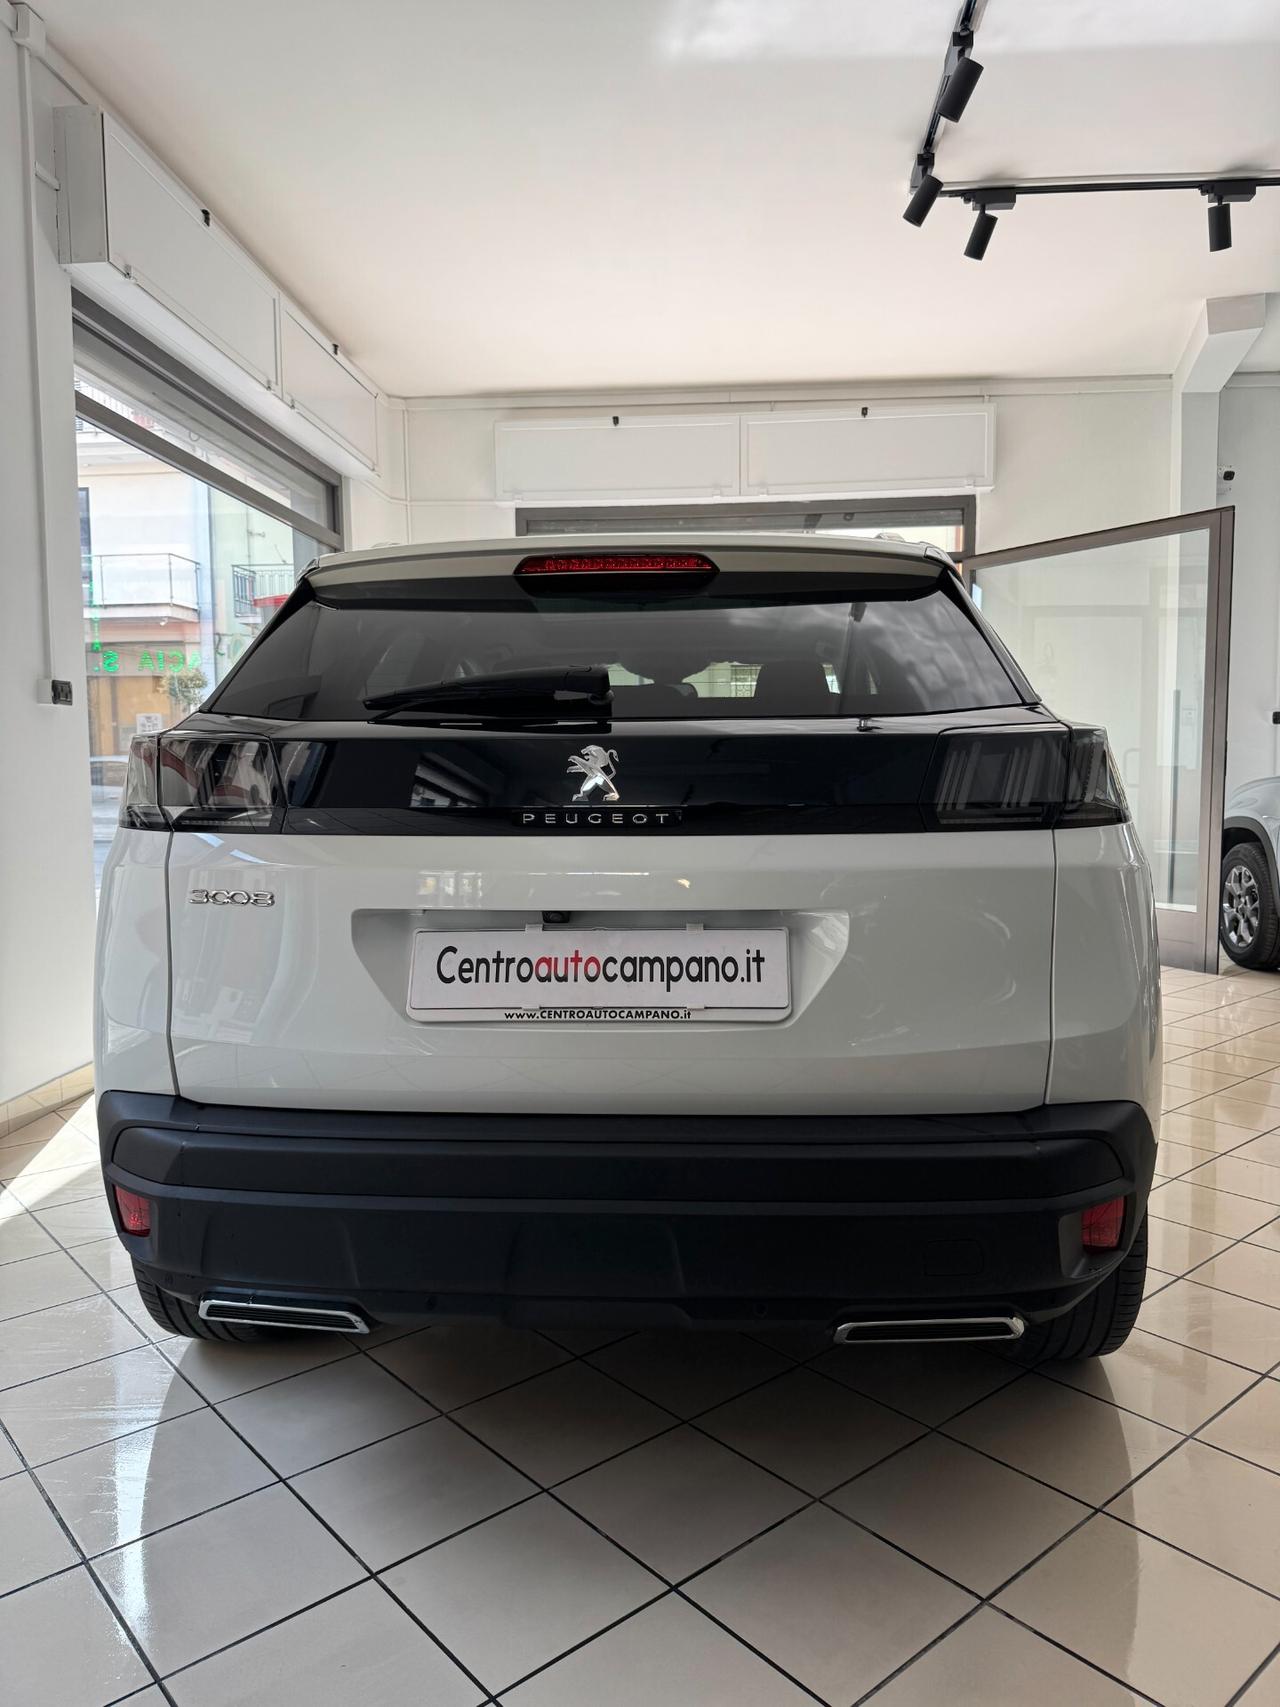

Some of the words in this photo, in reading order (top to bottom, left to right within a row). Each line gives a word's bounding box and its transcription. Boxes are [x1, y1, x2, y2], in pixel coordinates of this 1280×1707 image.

[522, 813, 669, 824] PEUGEOT
[189, 889, 275, 907] 3008
[436, 945, 765, 992] Centroautocampano.it
[504, 1009, 692, 1020] www.CENTROAUTOCAMPANO.it
